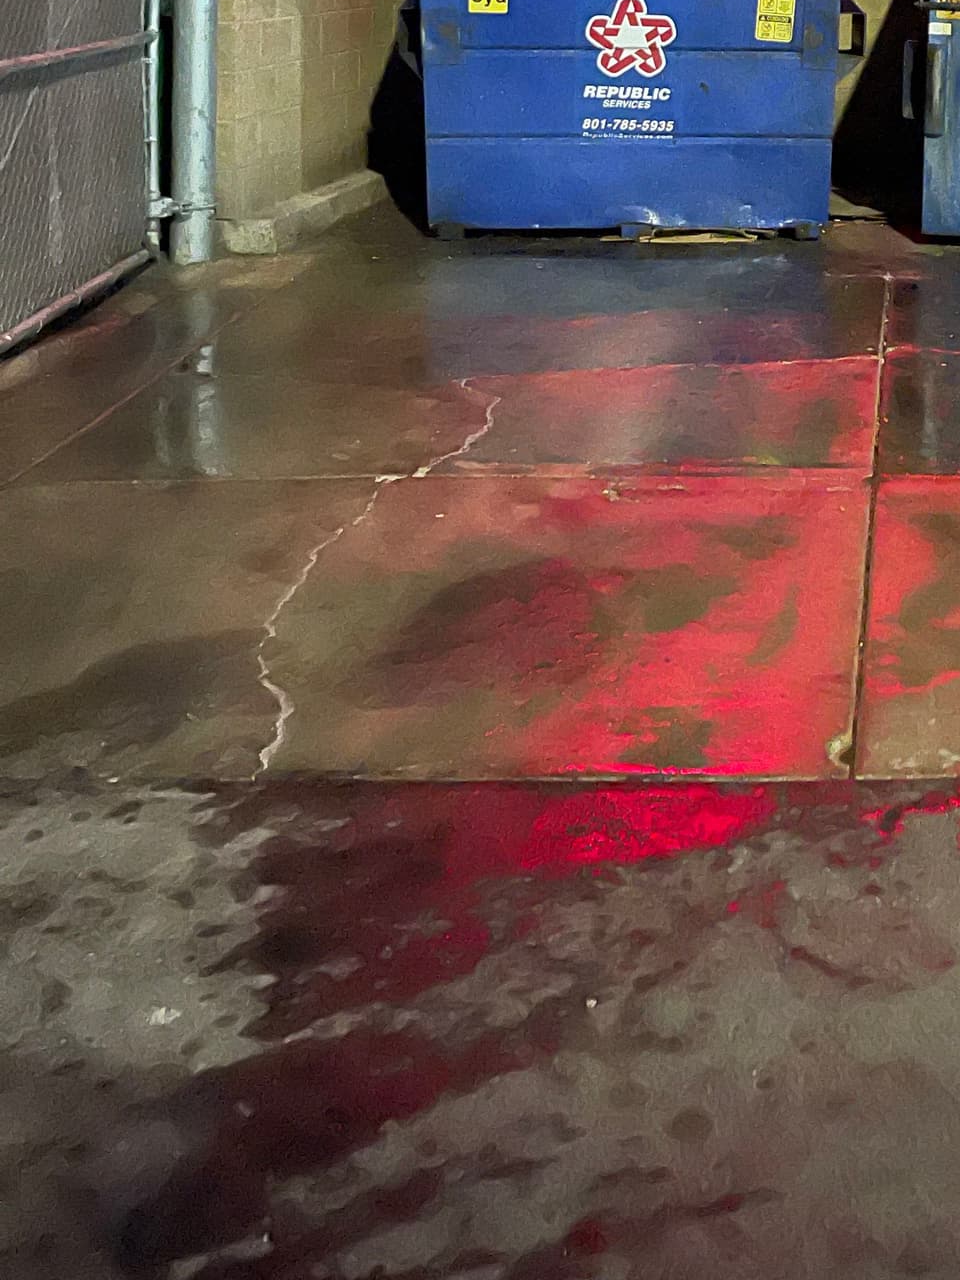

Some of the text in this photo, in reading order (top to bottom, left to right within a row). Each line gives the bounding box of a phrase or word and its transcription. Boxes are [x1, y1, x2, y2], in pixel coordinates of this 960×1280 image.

[583, 85, 671, 101] REPUBLIC
[602, 99, 651, 109] SERVICES
[582, 118, 675, 132] 801-785-5935
